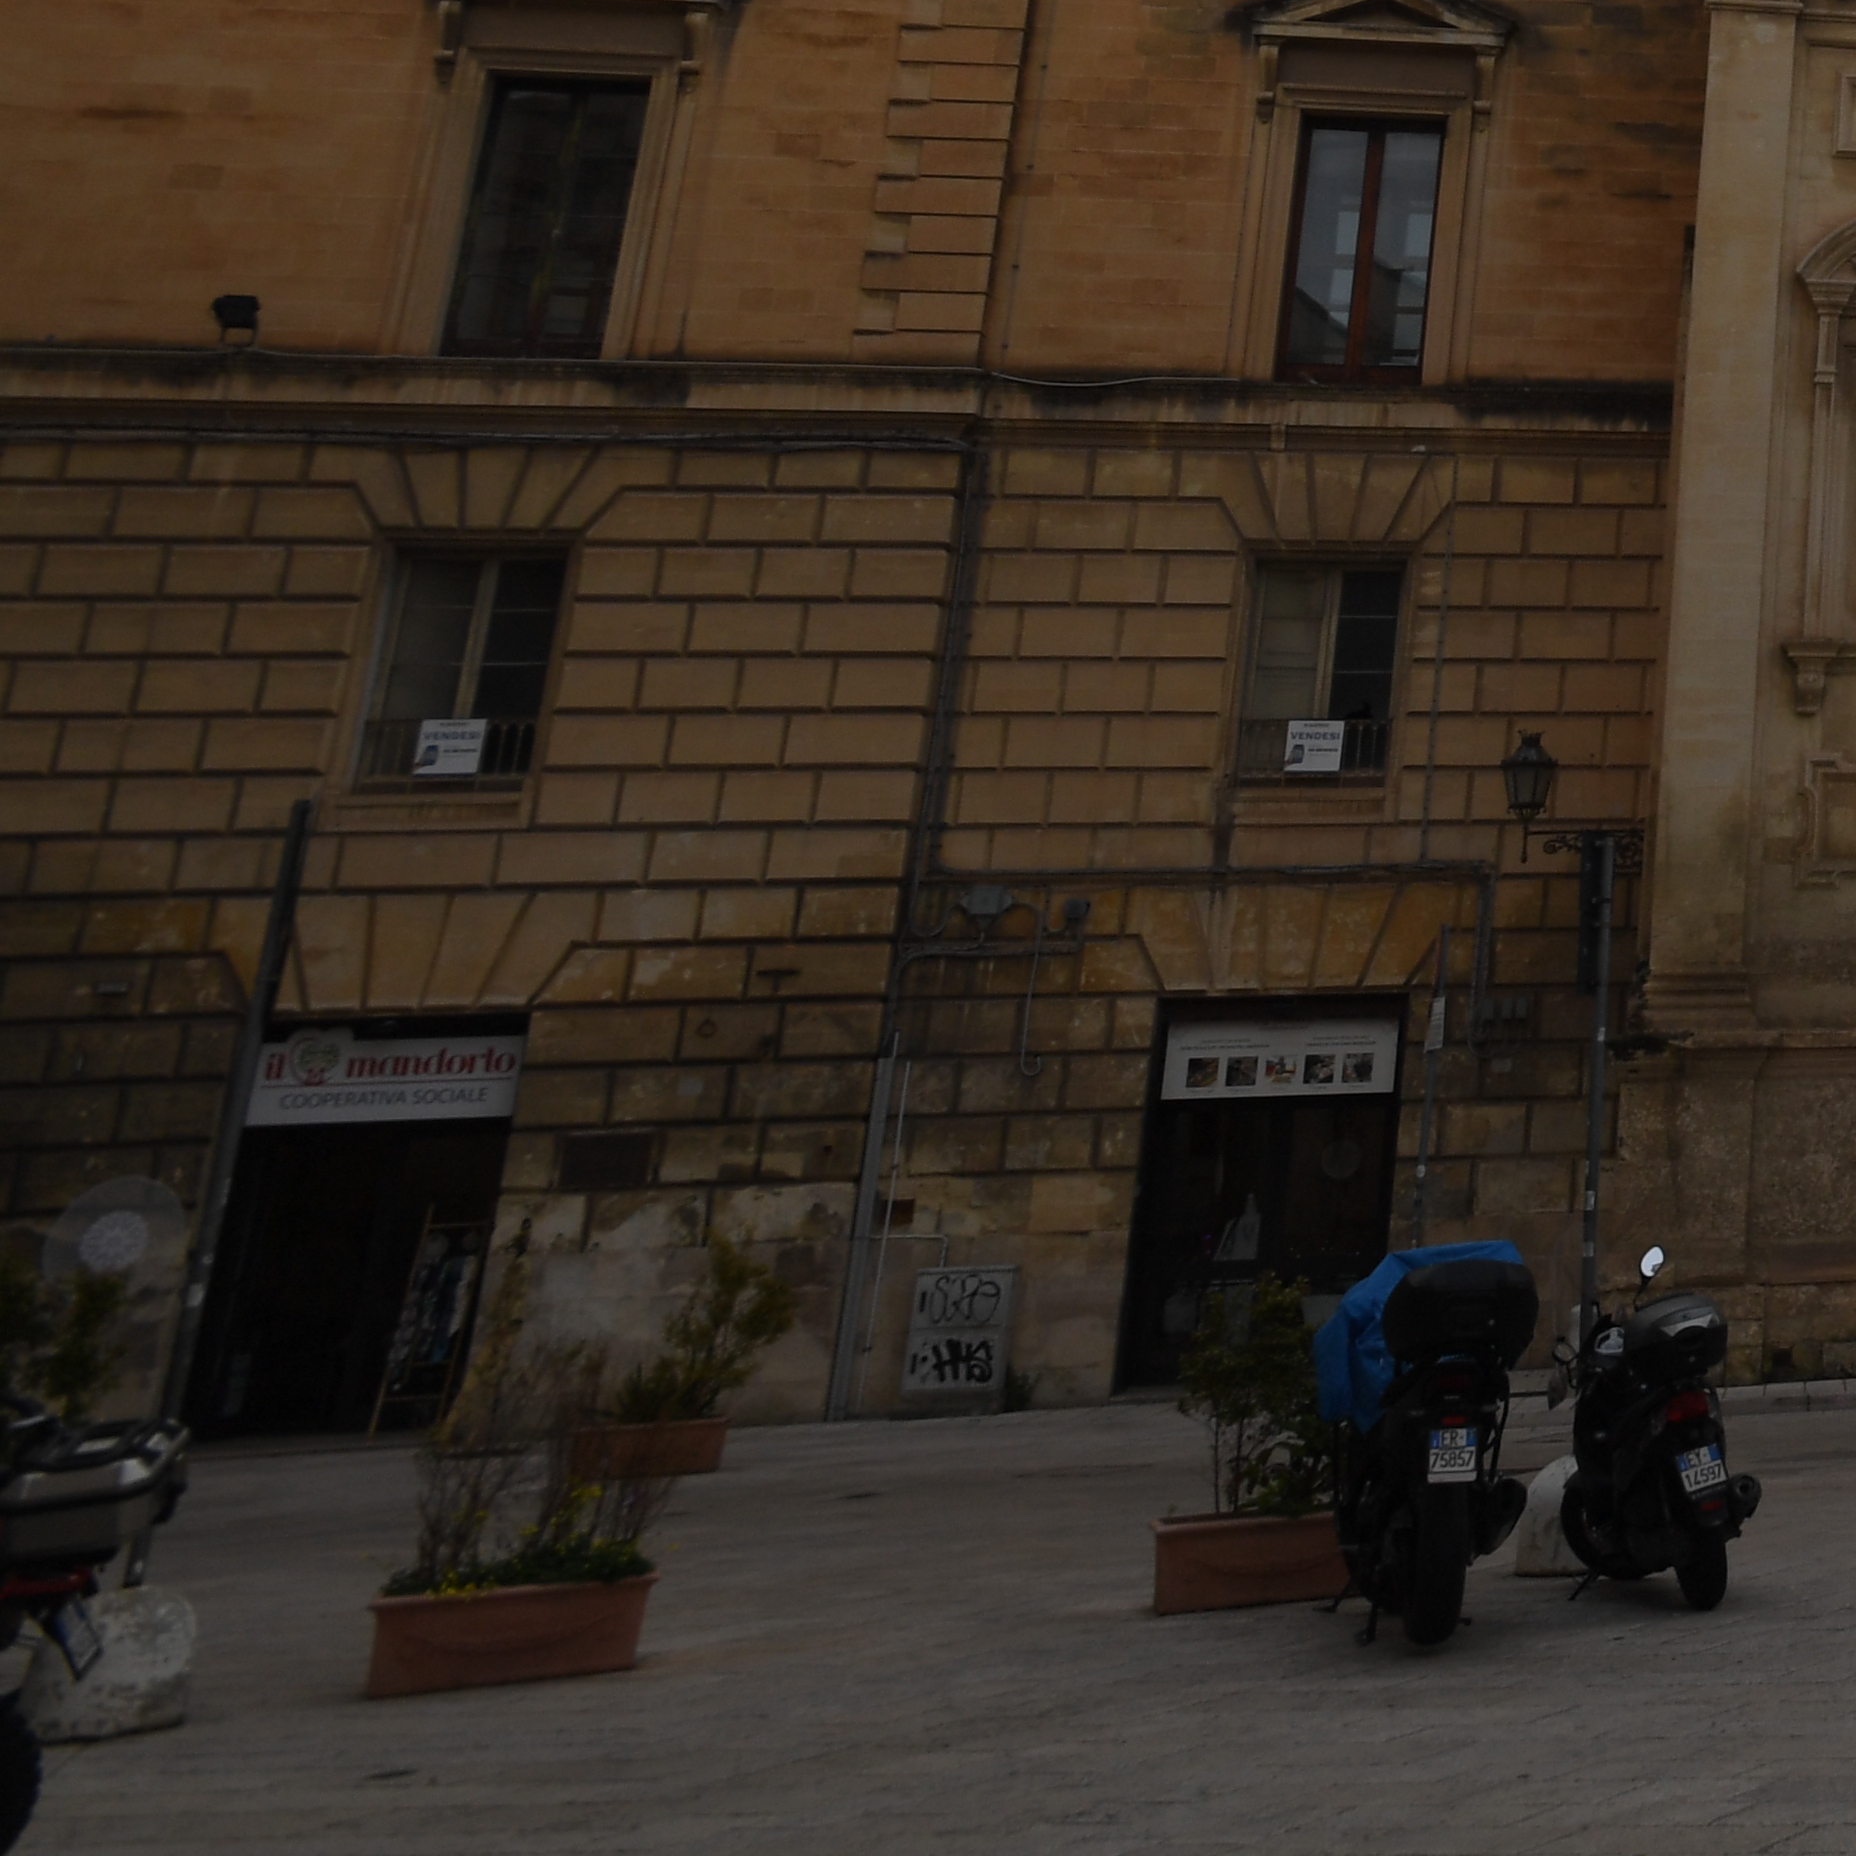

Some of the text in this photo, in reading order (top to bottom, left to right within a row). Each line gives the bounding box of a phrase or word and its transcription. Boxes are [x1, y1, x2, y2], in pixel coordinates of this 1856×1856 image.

[1290, 731, 1341, 740] VENDESI
[265, 1047, 517, 1080] il mandorlo
[279, 1086, 488, 1110] COOPERATIVA SOCIALE
[1430, 1450, 1474, 1469] 75857
[1685, 1463, 1721, 1488] 14597
